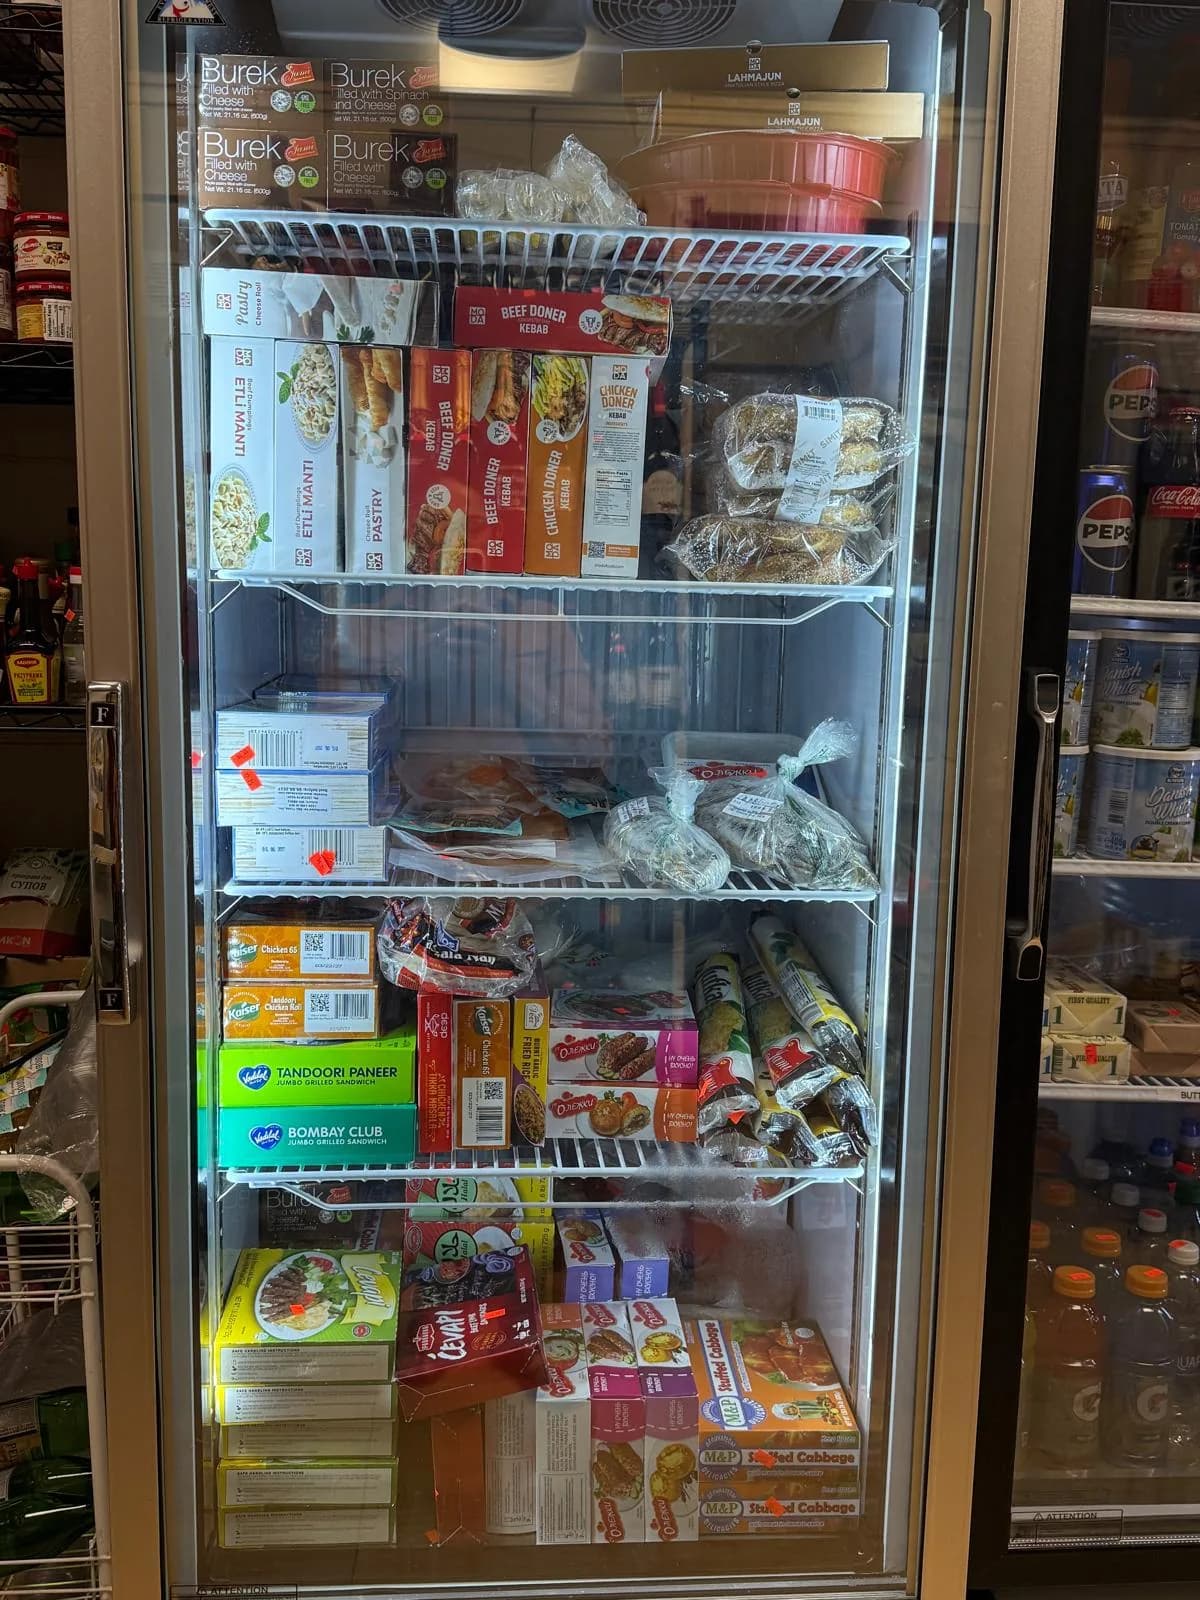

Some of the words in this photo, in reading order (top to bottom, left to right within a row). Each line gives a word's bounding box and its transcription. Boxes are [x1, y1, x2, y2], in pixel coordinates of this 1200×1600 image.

[202, 57, 278, 85] Burek
[331, 63, 406, 88] Burek
[727, 71, 782, 82] LAHMAJUN
[202, 84, 229, 95] Filled
[232, 86, 254, 96] with
[361, 88, 383, 99] with
[386, 88, 429, 101] Spinach
[202, 94, 244, 107] Cheese
[355, 99, 397, 110] Cheese
[767, 117, 820, 127] LAHMAJUN
[204, 131, 282, 160] Burek
[333, 134, 410, 162] Burek
[204, 157, 232, 170] Filled
[235, 160, 257, 171] with
[333, 160, 361, 171] Filled
[364, 161, 386, 172] with
[204, 169, 248, 182] Cheese
[333, 170, 376, 183] Cheese
[236, 280, 253, 326] Pastry
[501, 304, 528, 320] BEEF
[530, 304, 567, 323] DONER
[519, 323, 549, 335] KEBAB
[600, 384, 638, 398] CHICKEN
[601, 396, 637, 409] DONER
[439, 401, 451, 430] BEEF
[235, 411, 246, 457] MANTI
[425, 420, 436, 452] KEBAB
[820, 430, 841, 449] SIMIT
[436, 431, 454, 471] DONER
[793, 448, 818, 468] SIMIT
[484, 457, 500, 495] DONER
[546, 450, 563, 487] DONER
[303, 460, 314, 508] MANTI
[501, 476, 512, 507] KEBAB
[560, 479, 571, 509] KEBAB
[372, 488, 383, 542] PASTRY
[484, 496, 498, 525] BEEF
[543, 489, 559, 536] CHICKEN
[1104, 681, 1137, 697] White
[98, 707, 108, 722] F
[1145, 786, 1191, 807] Danish
[10, 880, 47, 892] СУПОВ
[261, 945, 288, 954] Chicken
[289, 945, 298, 954] 65
[106, 993, 117, 1006] F
[264, 1003, 288, 1011] Chicken
[270, 996, 296, 1005] Tandoori
[228, 1002, 260, 1021] Kaiser
[475, 1006, 491, 1036] Kaiser
[1053, 1005, 1062, 1024] 1
[1113, 1006, 1124, 1025] 1
[440, 1012, 449, 1039] deep
[482, 1039, 491, 1064] Chicken
[522, 1037, 532, 1059] FRIED
[277, 1067, 345, 1078] TANDOORI
[350, 1067, 397, 1078] PANEER
[482, 1067, 490, 1075] 65
[522, 1062, 531, 1079] RICE
[438, 1081, 446, 1119] CHICKEN
[288, 1127, 344, 1138] BOMBAY
[349, 1126, 383, 1137] CLUB
[460, 1179, 468, 1201] Halal
[705, 1322, 724, 1359] Cabbage
[711, 1361, 732, 1392] Stuffed
[721, 1398, 742, 1423] M&P
[1136, 1385, 1168, 1422] G
[704, 1452, 737, 1463] M&P
[797, 1451, 855, 1464] Cabbage
[705, 1503, 738, 1513] M&P
[798, 1502, 856, 1515] Cabbage
[1046, 1512, 1097, 1521] ATTENTION
[211, 1586, 269, 1595] ATTENTION
